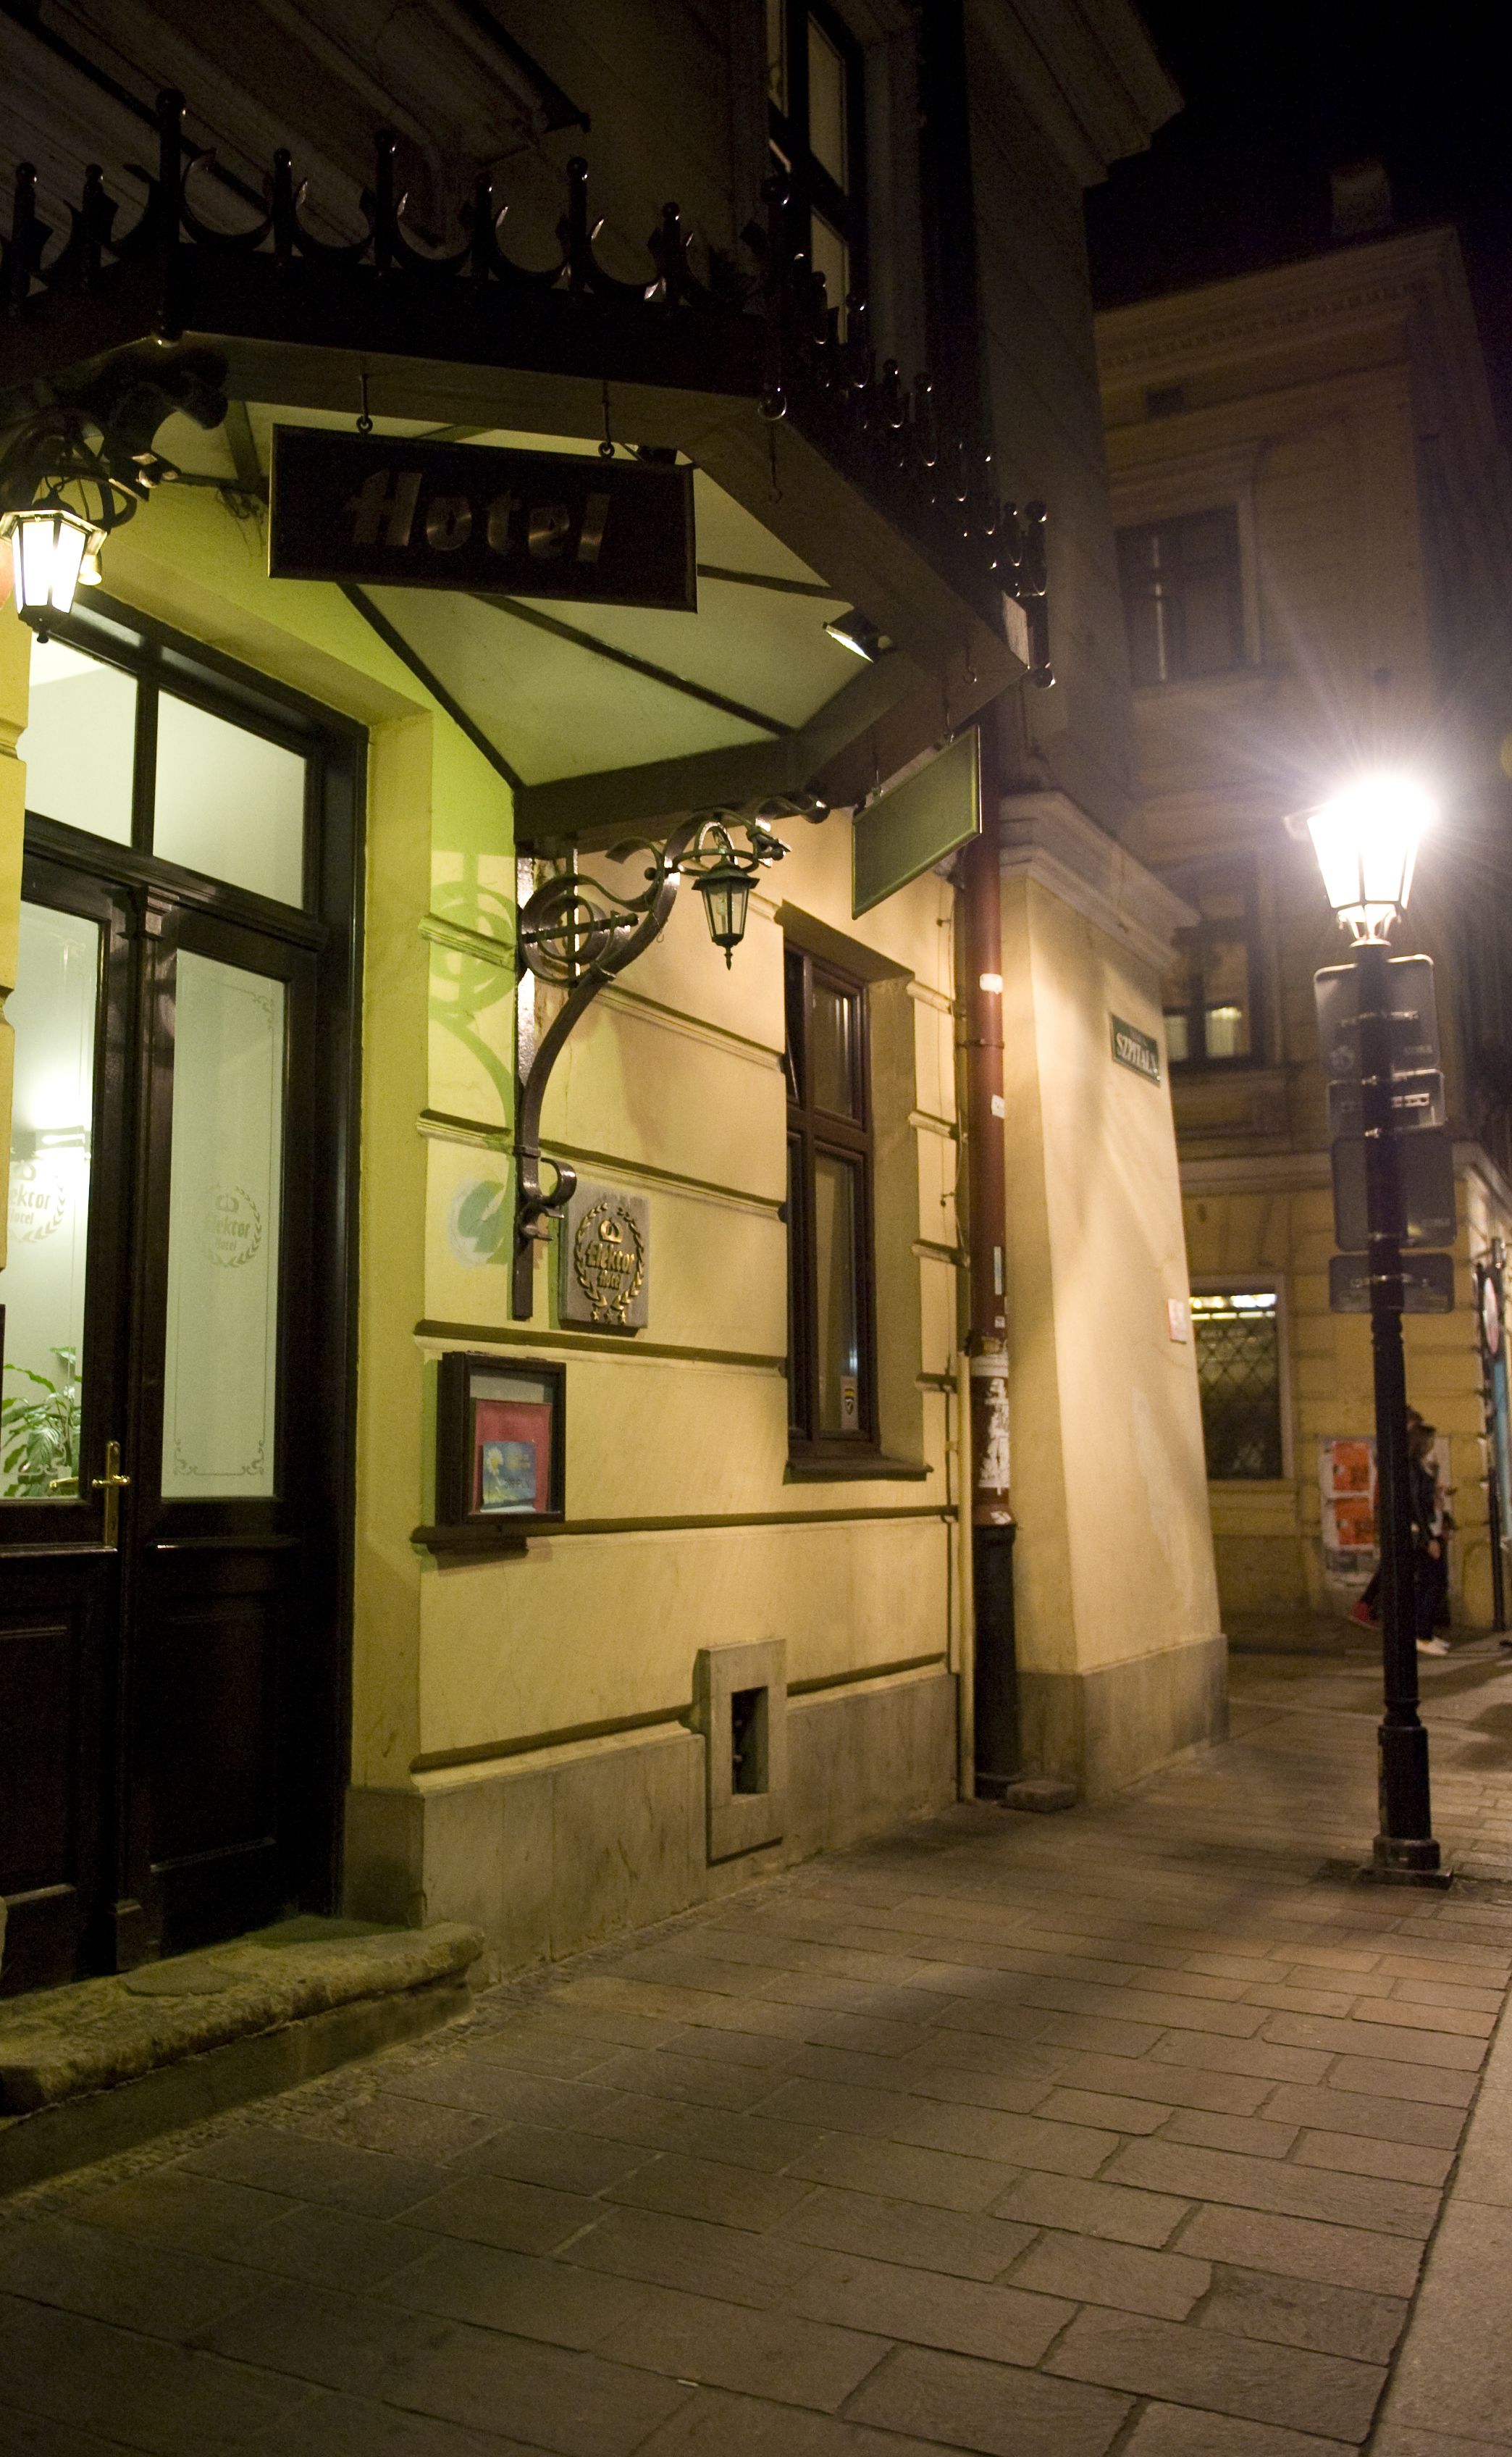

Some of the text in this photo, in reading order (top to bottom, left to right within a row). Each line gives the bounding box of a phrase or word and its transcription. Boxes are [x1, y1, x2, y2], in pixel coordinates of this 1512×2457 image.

[342, 468, 612, 564] Hotel
[9, 1184, 51, 1210] ektor
[205, 1215, 251, 1239] ektor
[586, 1240, 635, 1273] Elektor
